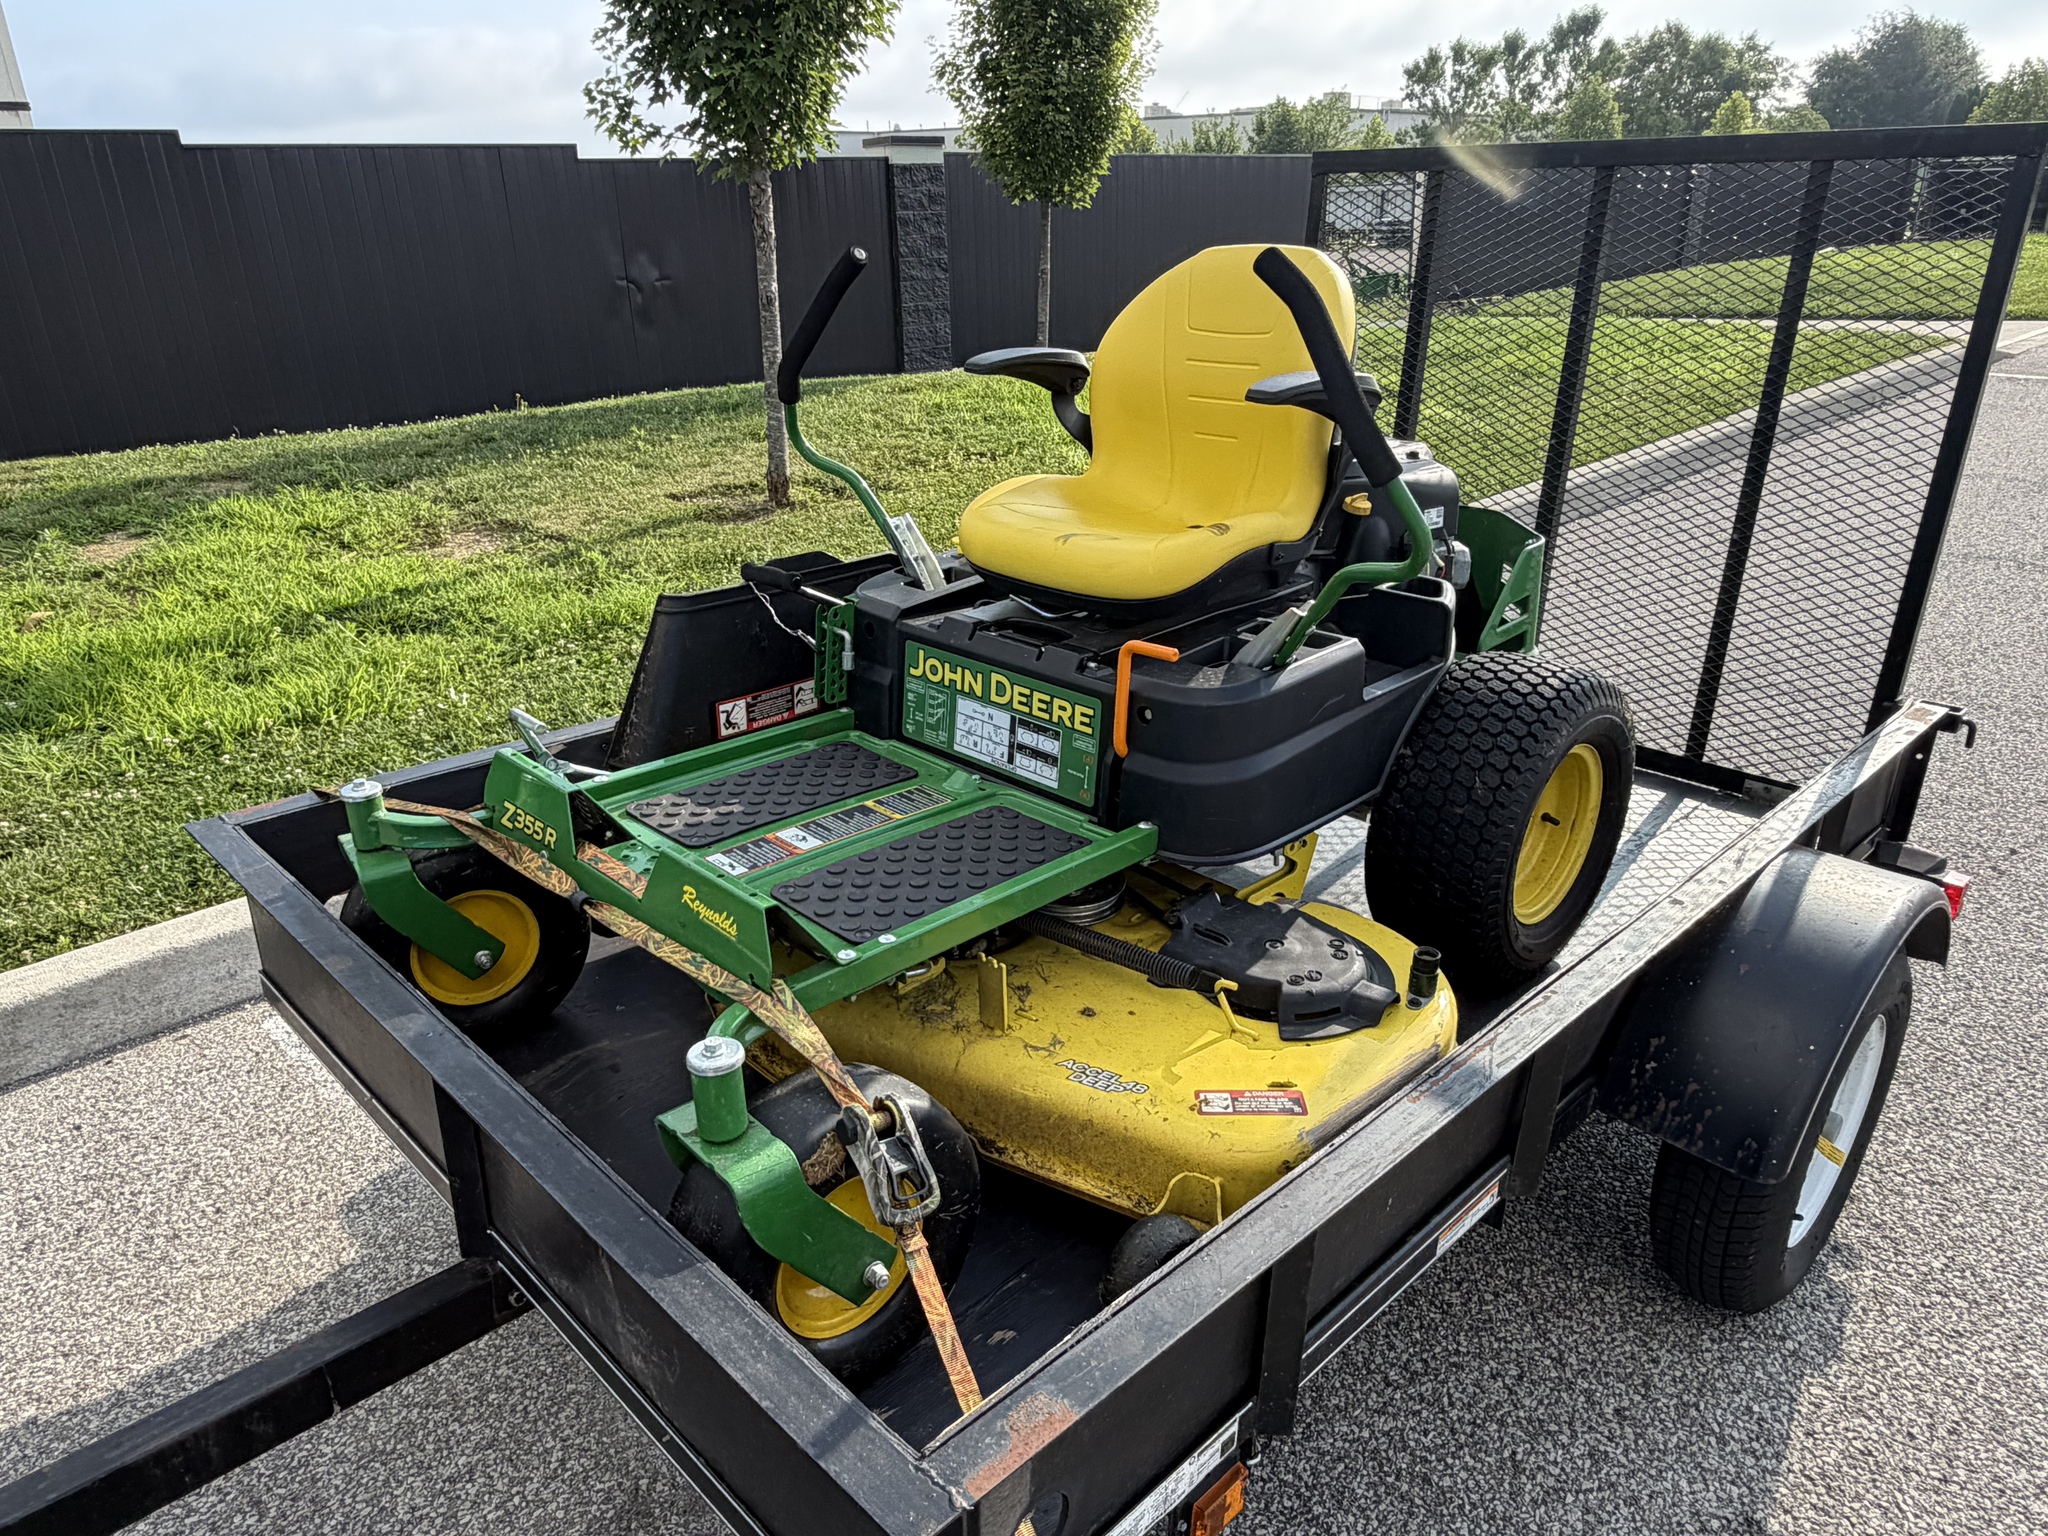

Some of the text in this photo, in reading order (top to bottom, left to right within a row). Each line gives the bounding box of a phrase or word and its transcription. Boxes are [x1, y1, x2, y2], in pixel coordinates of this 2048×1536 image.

[909, 649, 982, 698] JOHN
[989, 673, 1095, 735] DEERE
[752, 713, 783, 729] DANGER
[681, 885, 739, 938] Reynolds
[1056, 1059, 1150, 1095] ACCEL 48
[1067, 1071, 1127, 1094] DEEP
